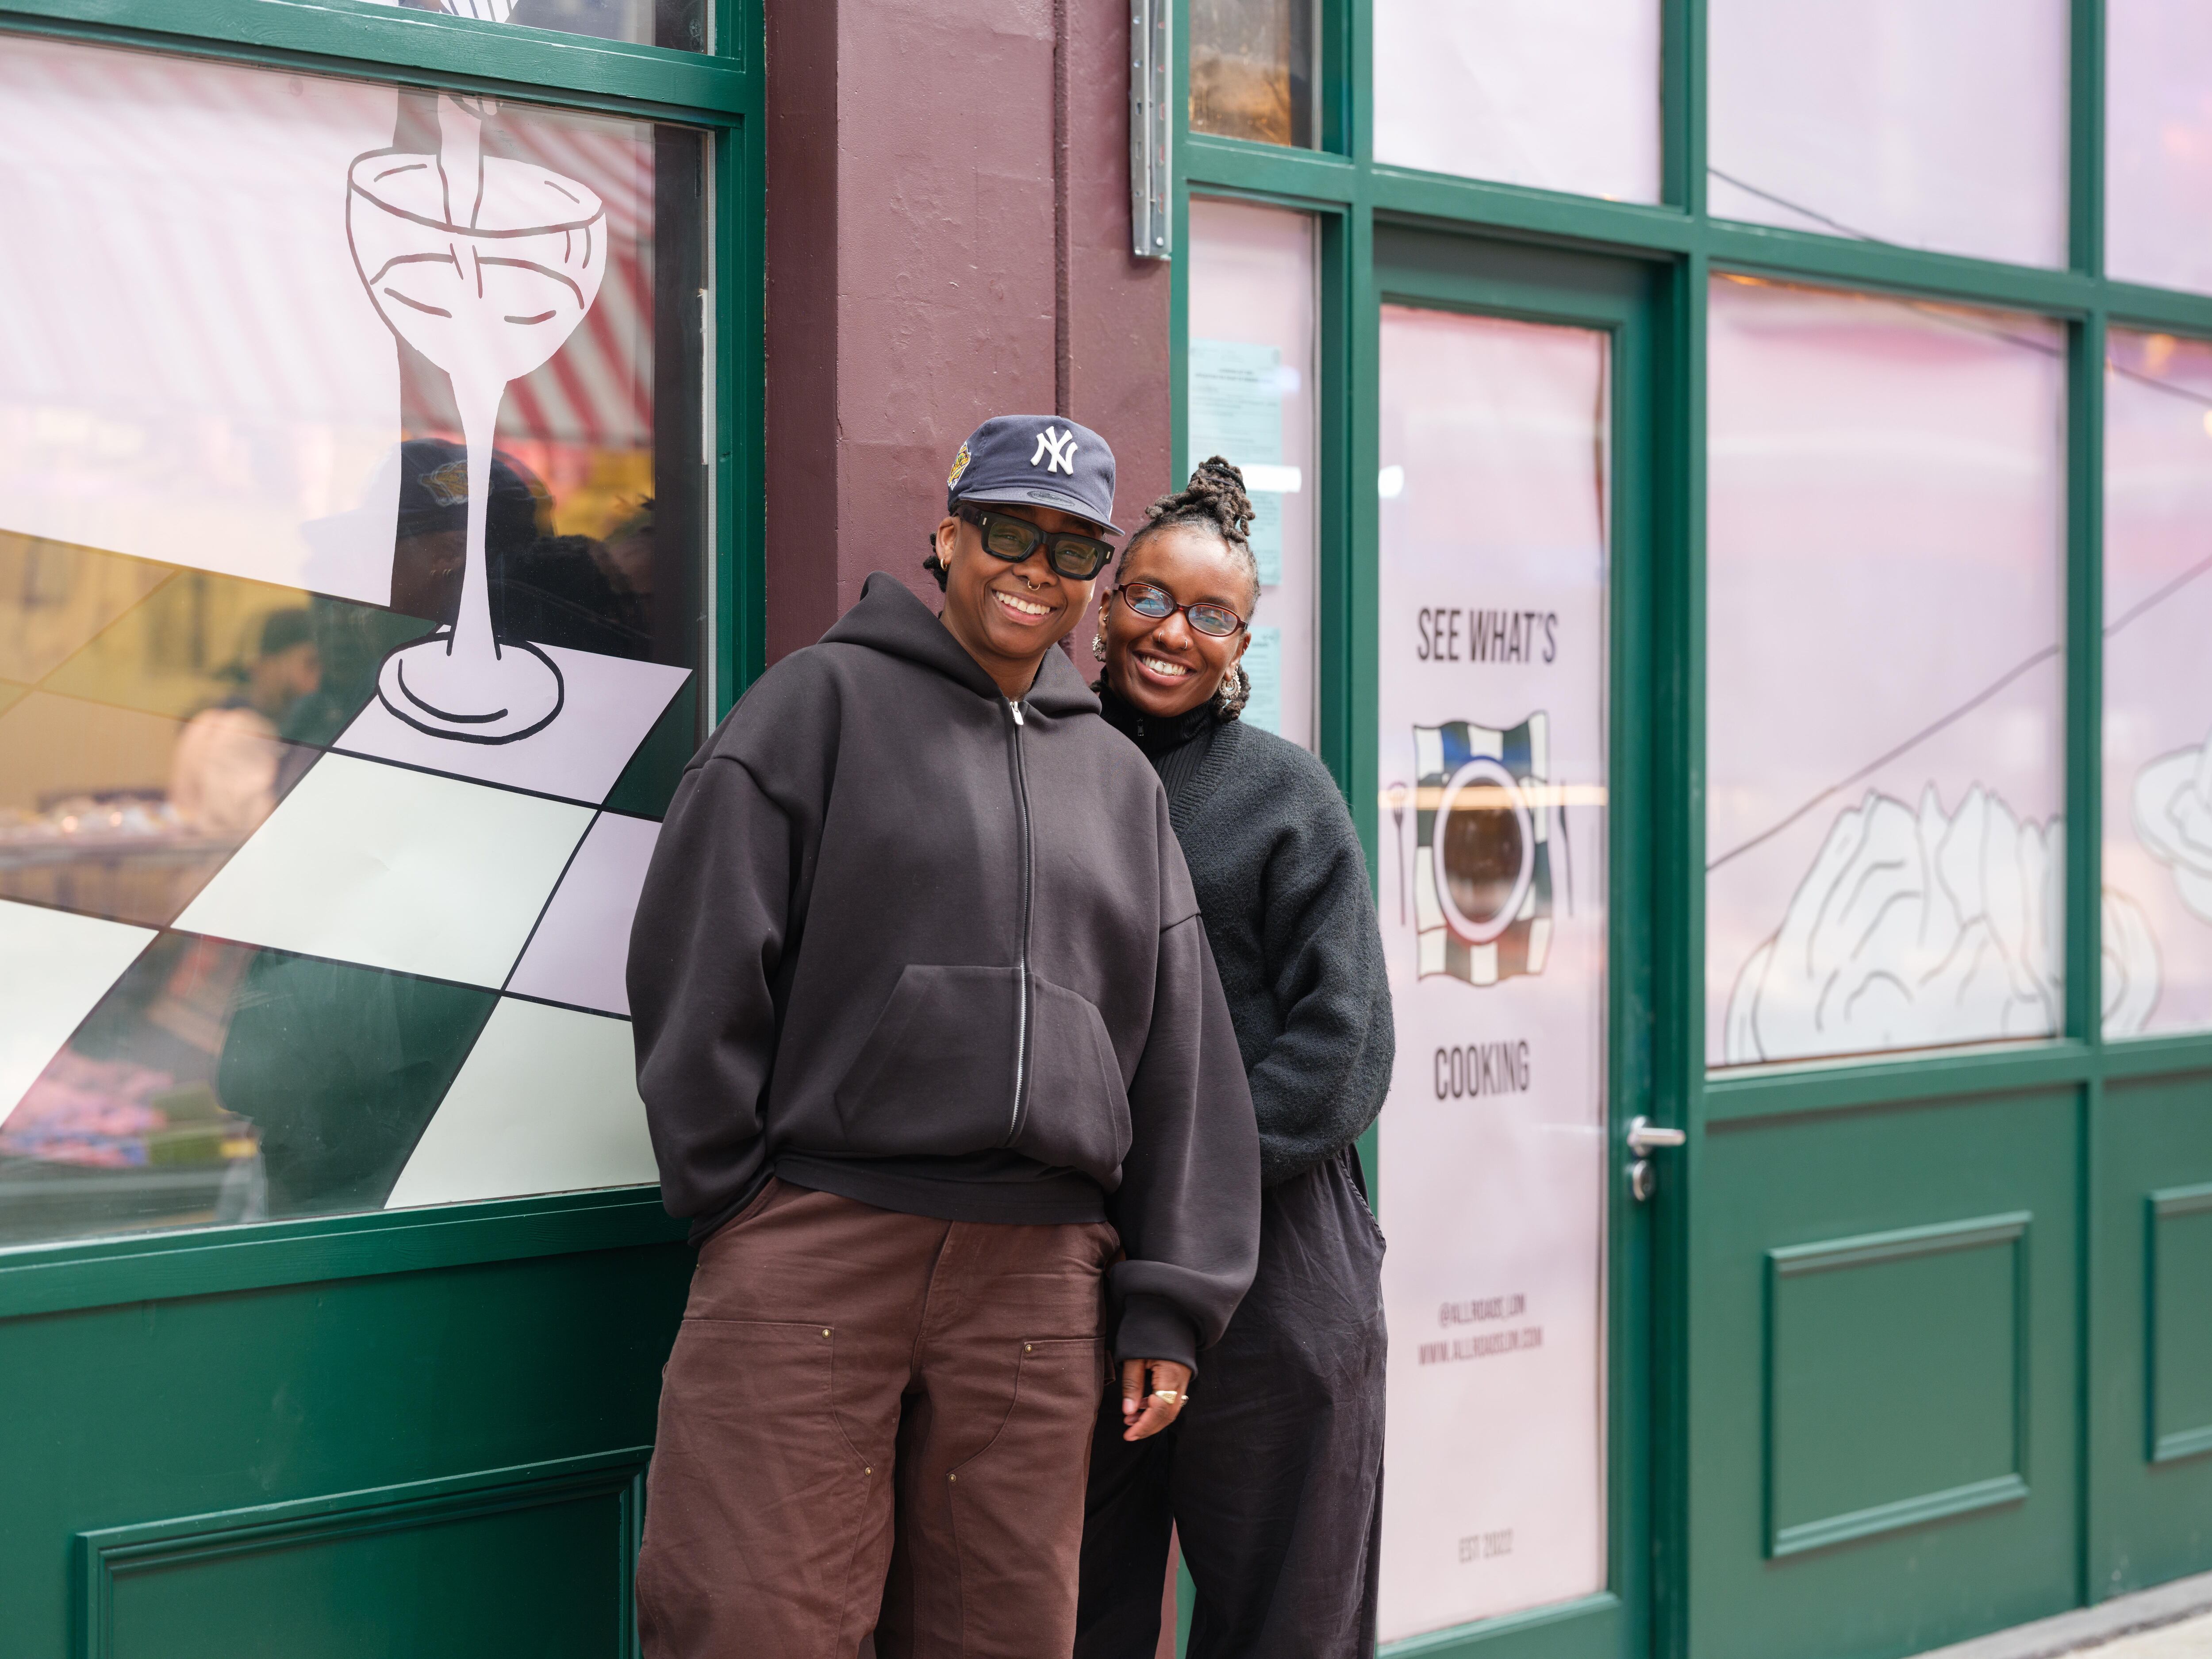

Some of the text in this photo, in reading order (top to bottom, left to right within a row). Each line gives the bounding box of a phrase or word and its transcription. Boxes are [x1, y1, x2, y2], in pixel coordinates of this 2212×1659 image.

[1030, 426, 1078, 475] NY
[1417, 607, 1558, 664] SEE WHAT'S
[1435, 1040, 1529, 1100] COOKING
